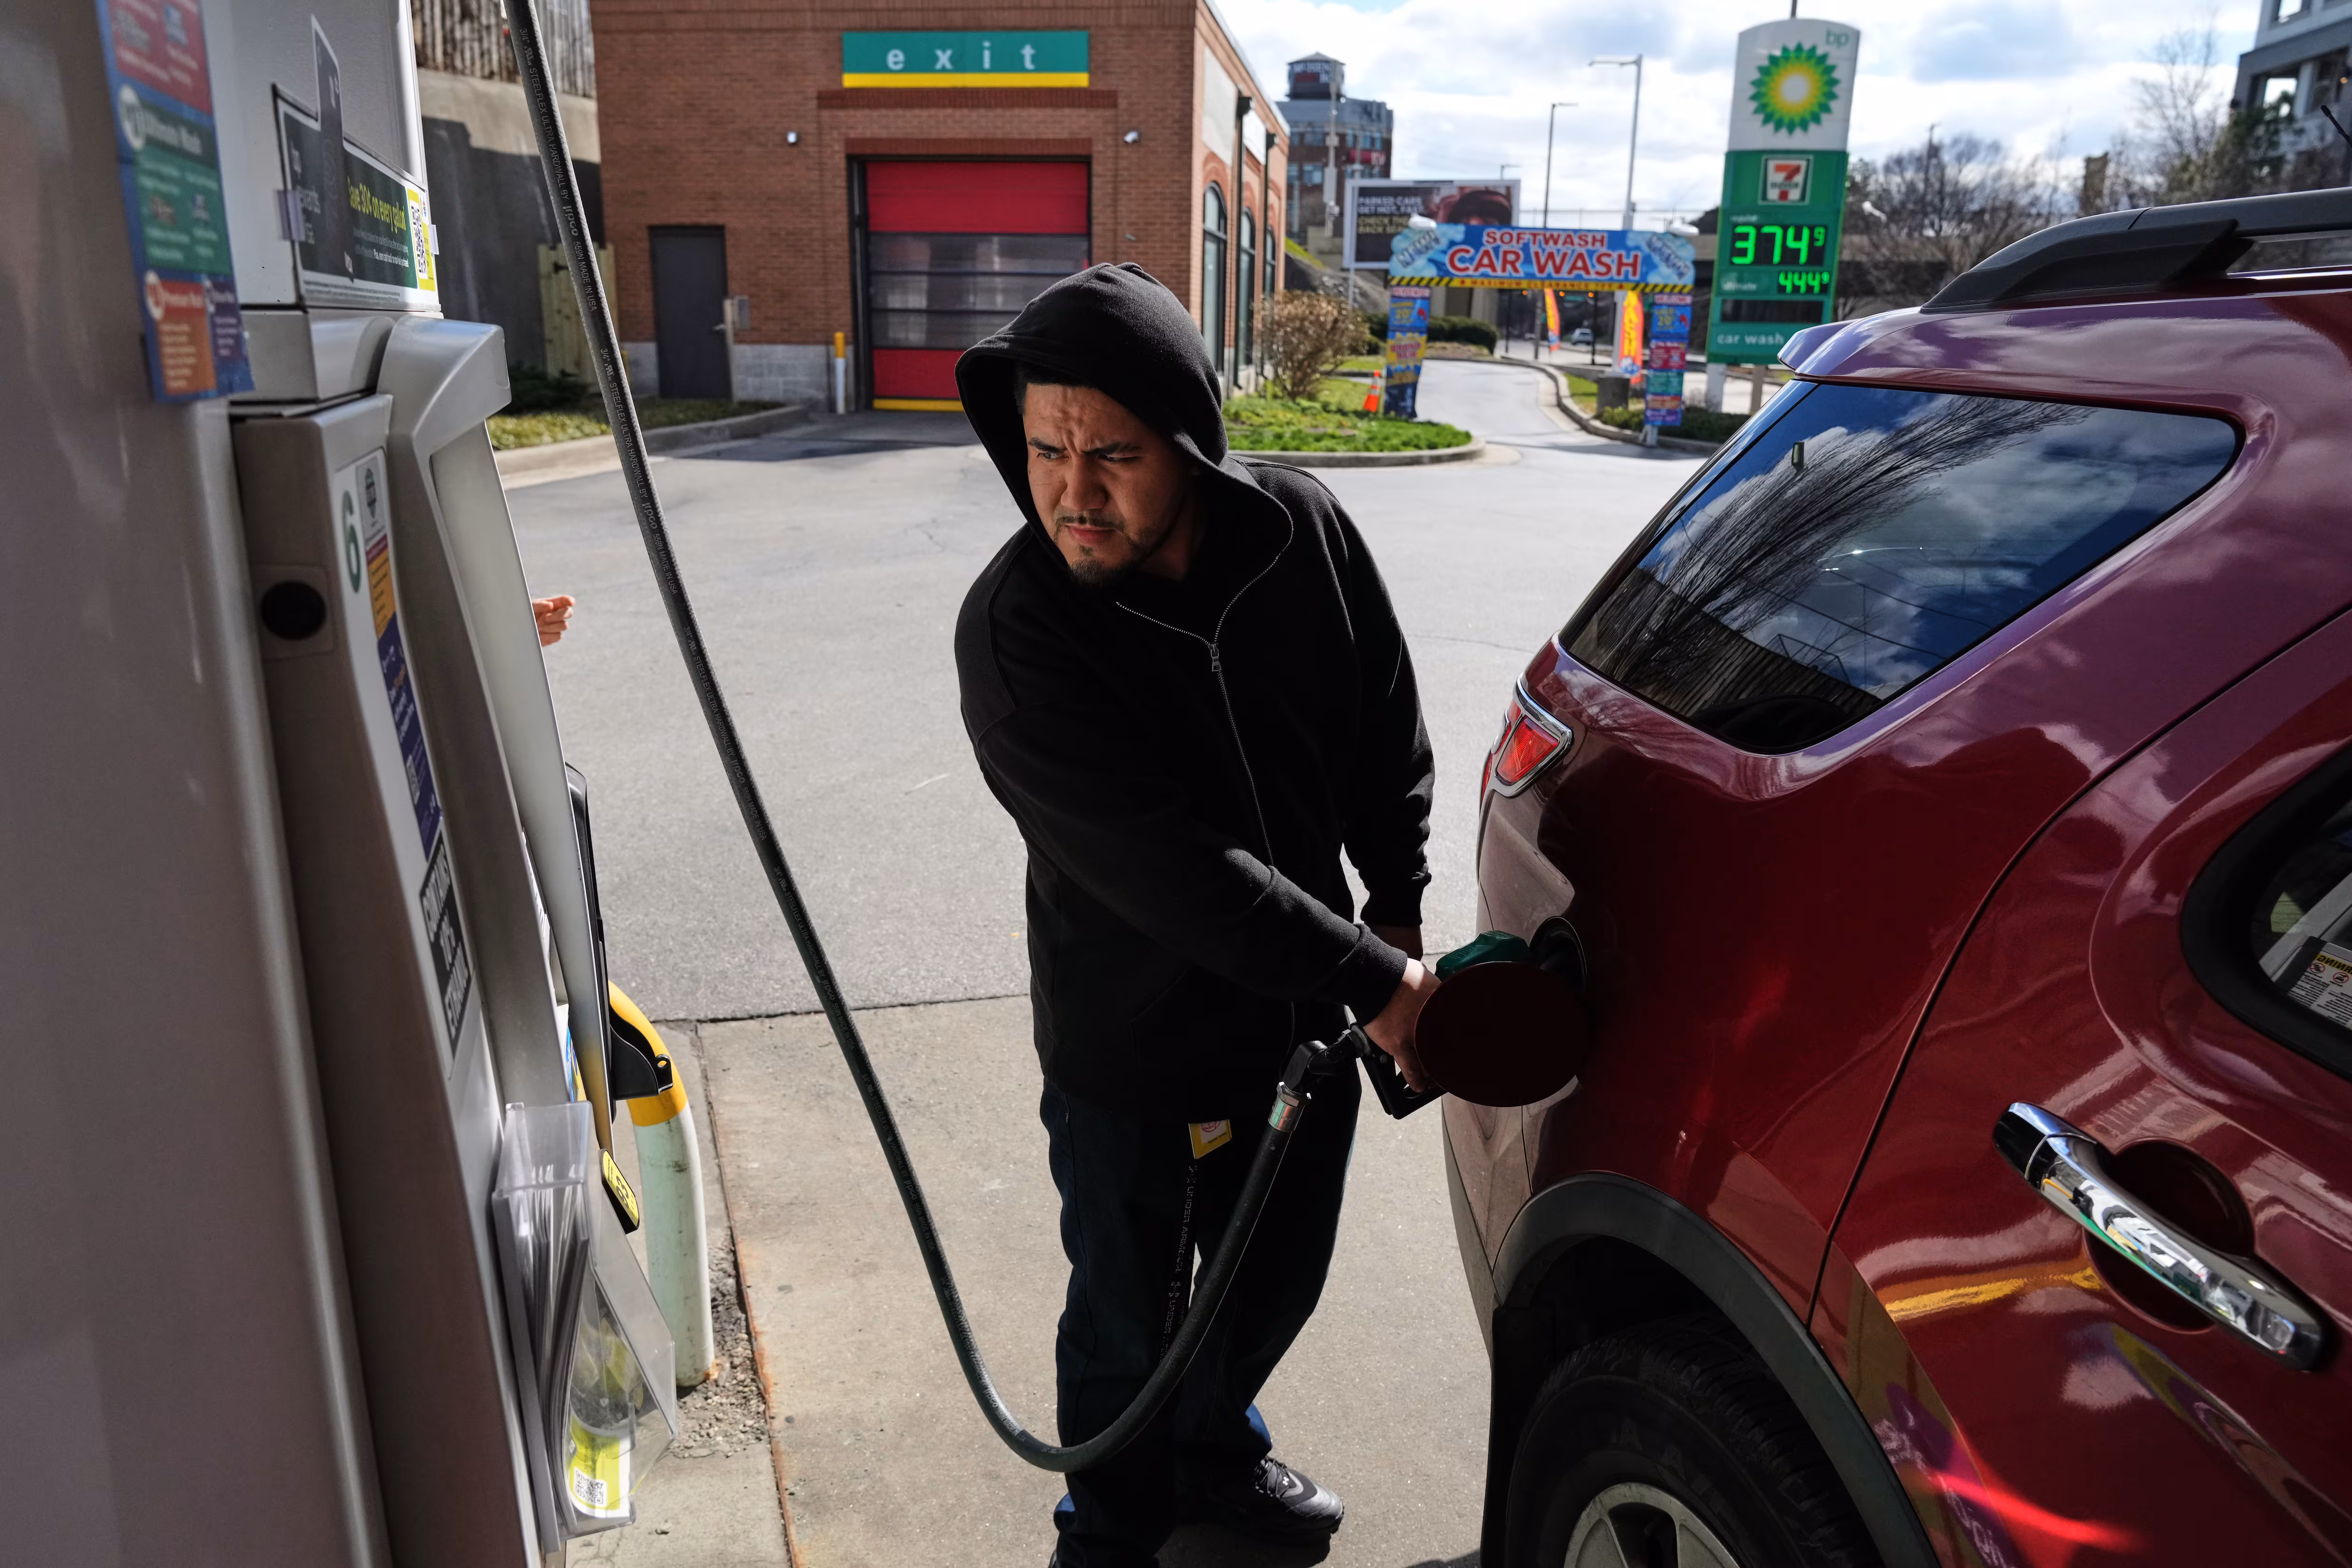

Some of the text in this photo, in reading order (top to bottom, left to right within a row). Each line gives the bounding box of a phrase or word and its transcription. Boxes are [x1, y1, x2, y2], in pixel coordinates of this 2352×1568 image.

[520, 29, 530, 43] 3/4"
[1826, 28, 1849, 49] bp
[886, 41, 1035, 70] exit
[530, 68, 548, 113] STEELFLEX
[542, 116, 555, 142] ULTRA
[549, 144, 566, 188] HARDWALL
[561, 190, 570, 200] BY
[372, 196, 381, 219] on
[379, 199, 393, 232] every
[392, 201, 406, 233] gallon
[1484, 230, 1606, 248] SOFTWASH
[573, 241, 584, 260] 559N
[579, 261, 590, 284] MADE
[1447, 248, 1521, 273] CAR
[1533, 250, 1639, 278] WASH
[585, 285, 593, 294] IN
[587, 295, 597, 311] USA
[1717, 332, 1784, 345] car wash
[601, 348, 610, 361] 3/4"
[610, 382, 627, 423] STEELFLEX
[621, 424, 633, 448] ULTRA
[628, 449, 644, 488] HARDWALL
[639, 488, 648, 498] BY
[342, 491, 361, 594] 6
[652, 533, 663, 550] 559N
[659, 551, 670, 570] MADE
[665, 571, 673, 580] IN
[668, 580, 678, 595] USA
[694, 656, 711, 692] STEELFLEX
[707, 692, 719, 714] ULTRA
[714, 713, 731, 749] HARDWALL
[727, 747, 735, 756] BY
[747, 801, 760, 820] MADE
[755, 819, 762, 828] IN
[757, 827, 767, 841] USA
[423, 844, 450, 942] CONTAINS
[440, 909, 455, 971] 10%
[785, 891, 802, 922] STEELFLEX
[798, 920, 810, 943] ULTRA
[805, 941, 823, 971] HARDWALL
[818, 969, 826, 980] BY
[837, 1015, 848, 1032] MADE
[846, 1038, 856, 1050] USA
[445, 941, 469, 1038] ETHANOL
[883, 1124, 892, 1141] ULTR
[616, 1175, 629, 1209] 93
[1183, 1186, 1194, 1223] UNDER
[1164, 1299, 1175, 1334] UNDER
[1003, 1418, 1015, 1433] MADE
[1012, 1428, 1020, 1436] IN
